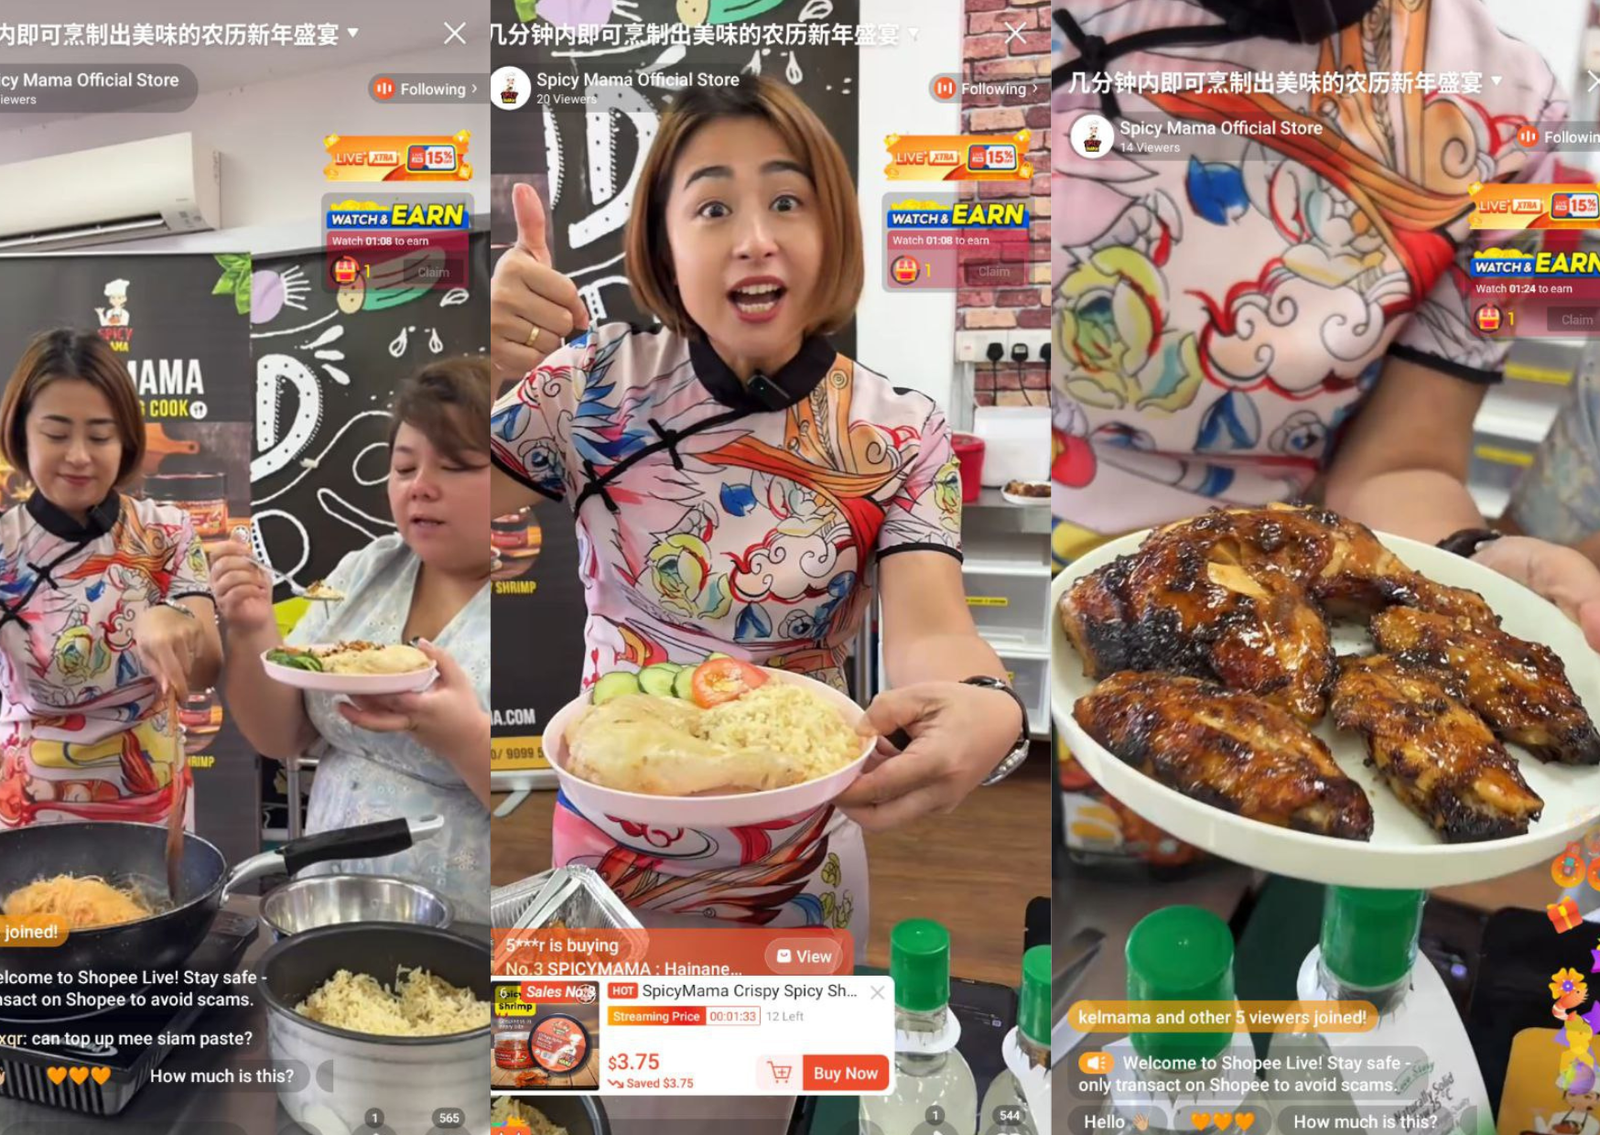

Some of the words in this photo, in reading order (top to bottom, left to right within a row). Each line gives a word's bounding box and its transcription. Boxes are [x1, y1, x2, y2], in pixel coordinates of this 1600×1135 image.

[151, 400, 189, 417] COOK
[496, 581, 537, 594] SHRIMP
[506, 747, 534, 760] 9099
[499, 1002, 533, 1012] Shrimp
